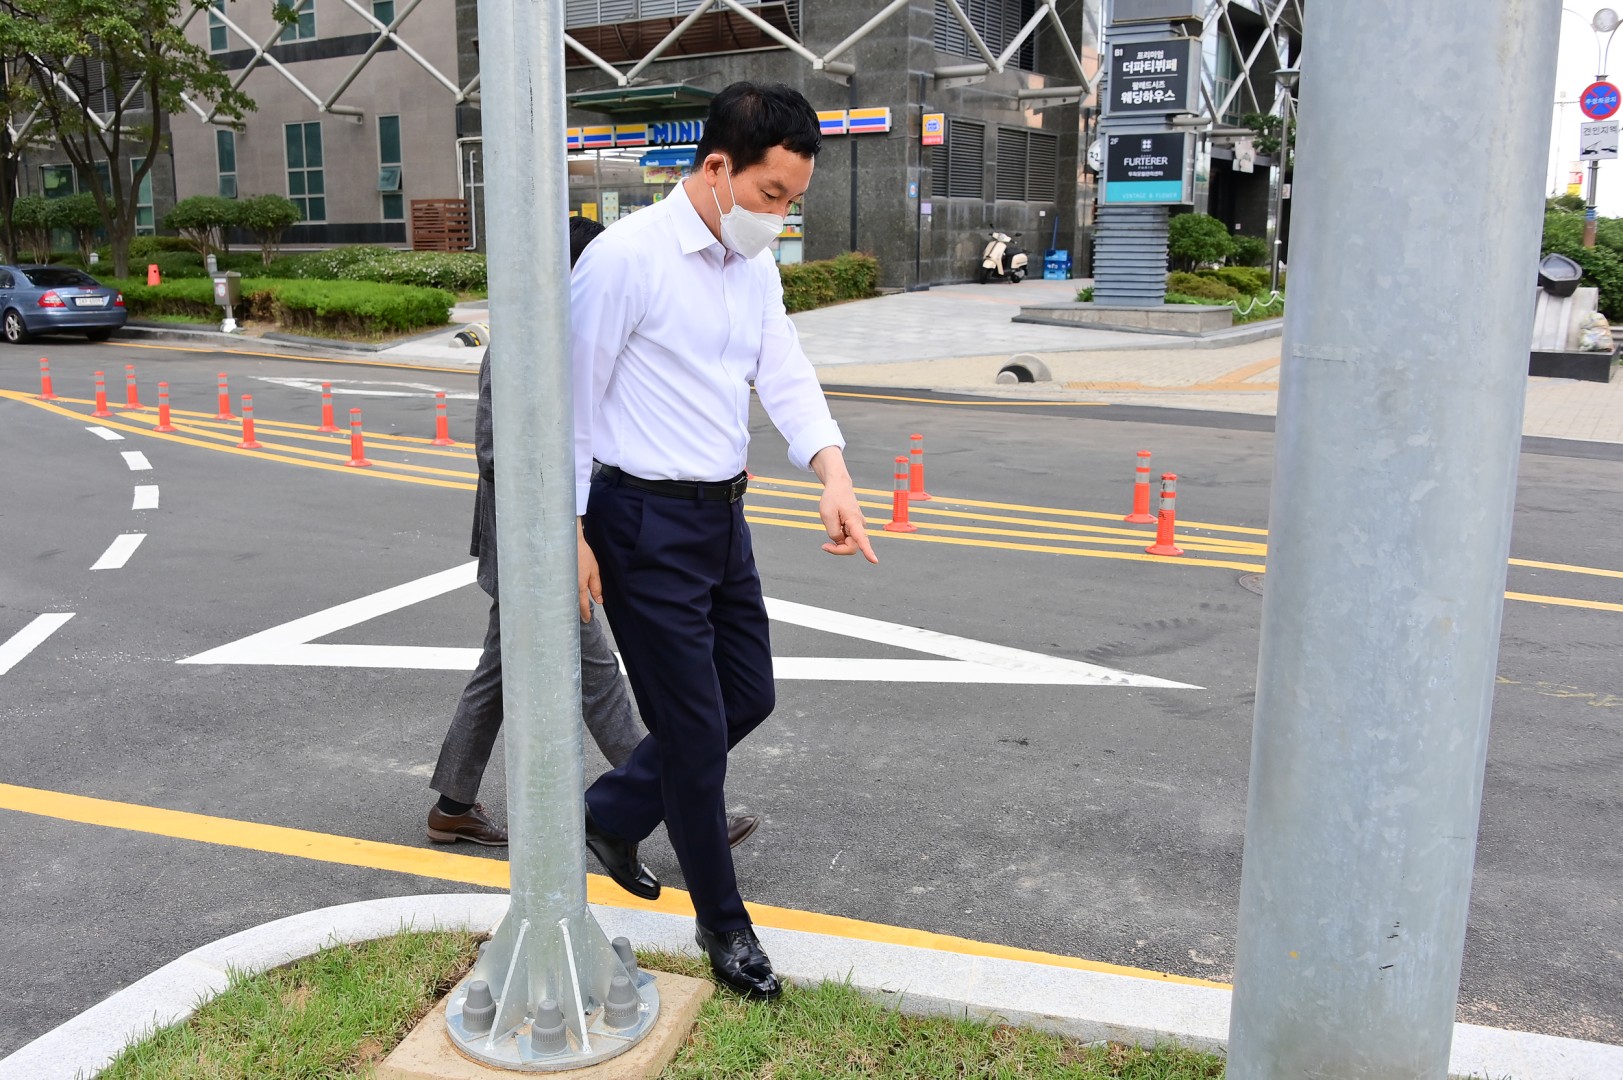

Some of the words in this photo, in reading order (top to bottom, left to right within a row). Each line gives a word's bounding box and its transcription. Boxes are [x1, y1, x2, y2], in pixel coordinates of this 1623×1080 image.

[1114, 48, 1123, 57] B1
[1136, 50, 1164, 59] 프리미엄
[1122, 58, 1178, 74] 더파티뷔페
[1121, 89, 1176, 104] 웨딩하우스
[653, 119, 704, 144] MINI
[1583, 126, 1617, 136] 견인지역
[1109, 137, 1119, 145] 2F
[1123, 156, 1168, 166] FURTERER
